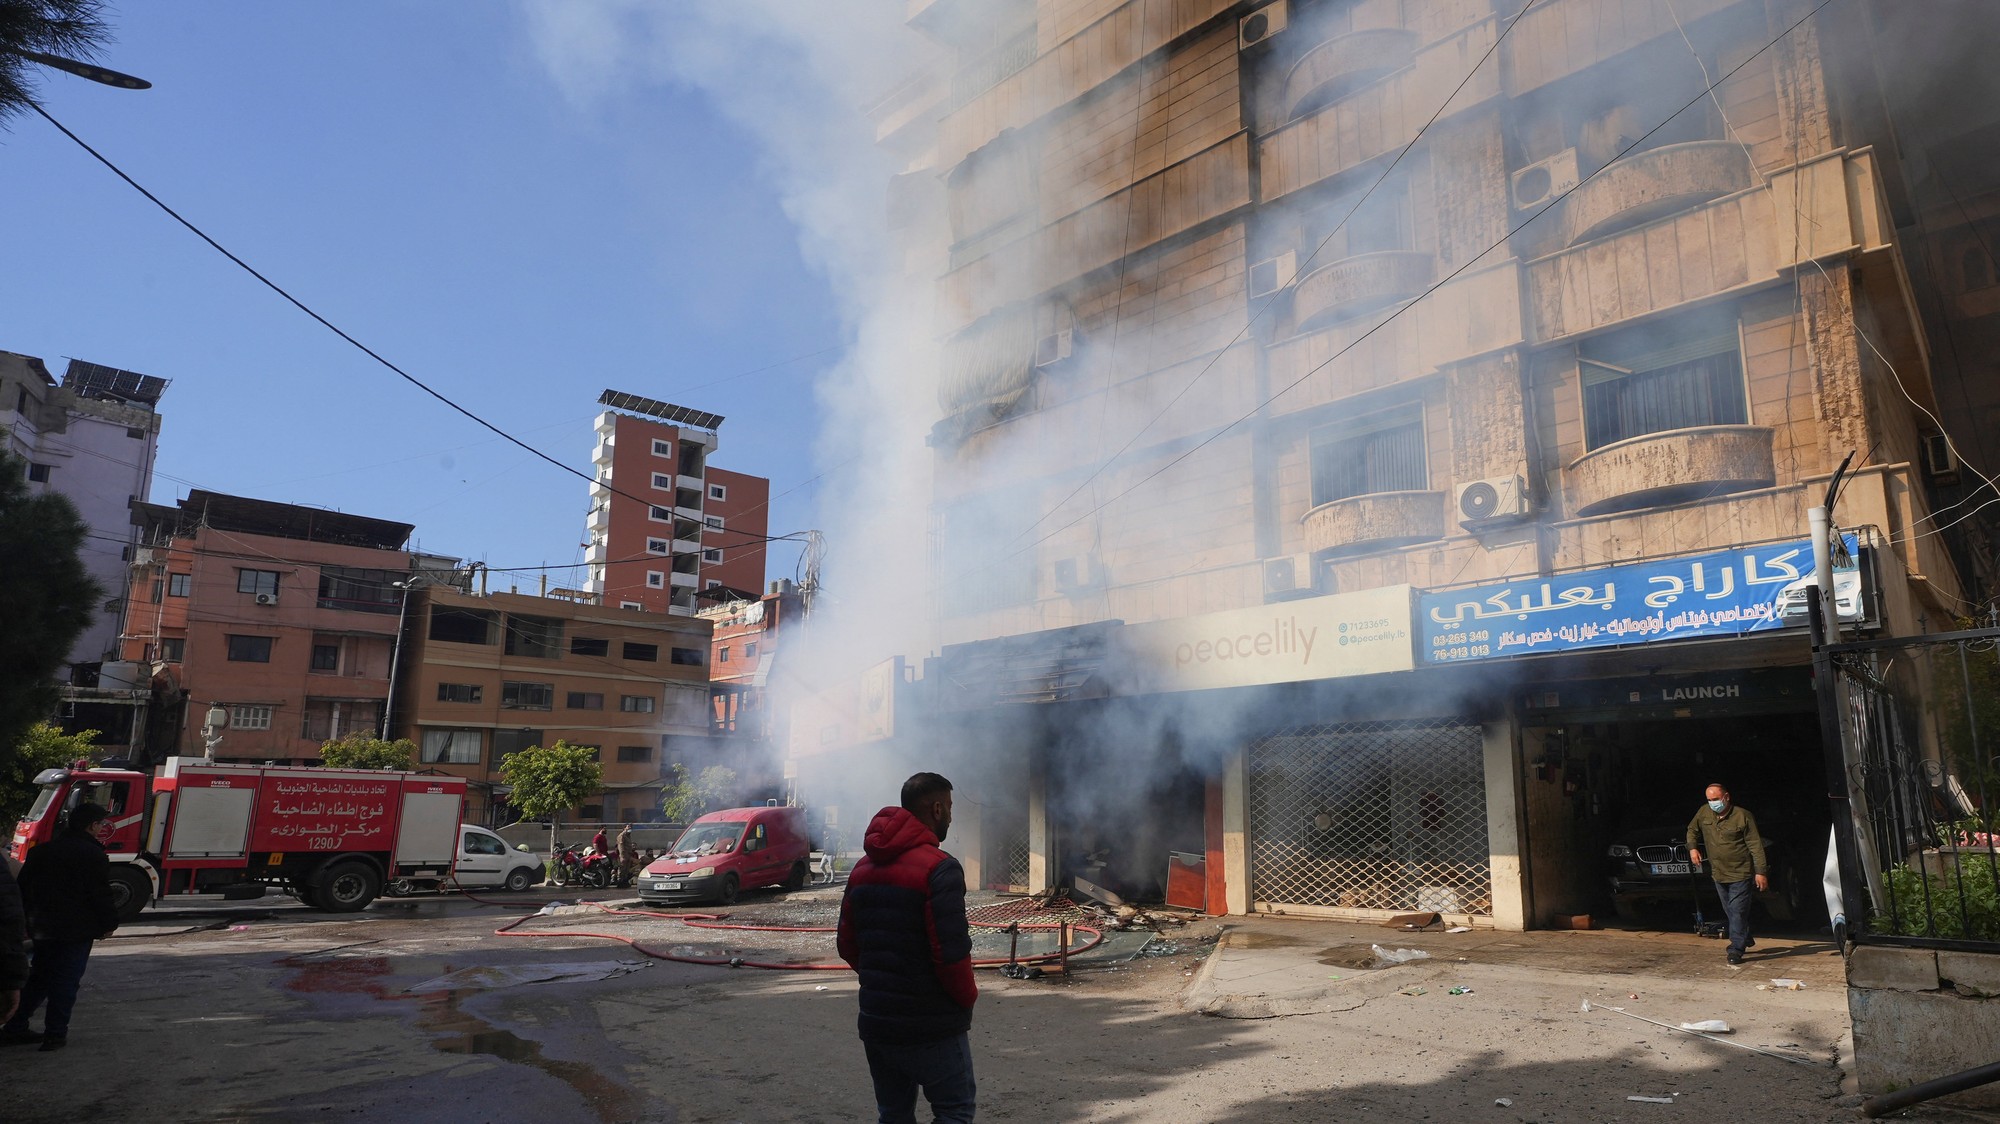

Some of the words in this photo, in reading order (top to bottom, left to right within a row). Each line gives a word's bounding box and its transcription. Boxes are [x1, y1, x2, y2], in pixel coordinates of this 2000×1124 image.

[1645, 549, 1799, 608] كاراج
[1430, 583, 1616, 630] بعلبكي
[1711, 602, 1773, 627] إختصاصي
[1349, 618, 1389, 631] 71233695
[1665, 609, 1709, 631] فيتاس
[1349, 630, 1406, 645] @peacelily.lb
[1469, 629, 1489, 642] 340
[1526, 627, 1552, 646] فحص
[1559, 624, 1578, 642] زيت
[1579, 622, 1599, 641] غيار
[1175, 616, 1318, 669] peacelily
[1471, 644, 1490, 656] 013
[1662, 685, 1740, 700] LAUNCH
[277, 781, 311, 796] الجنوبية
[312, 782, 343, 795] الضاحية
[343, 784, 369, 796] بلديات
[272, 800, 325, 818] الضاحية
[327, 802, 358, 819] إطفاء
[360, 802, 384, 820] فوج
[341, 823, 381, 836] مركز
[1657, 865, 1663, 873] B
[1667, 864, 1697, 873] 62086
